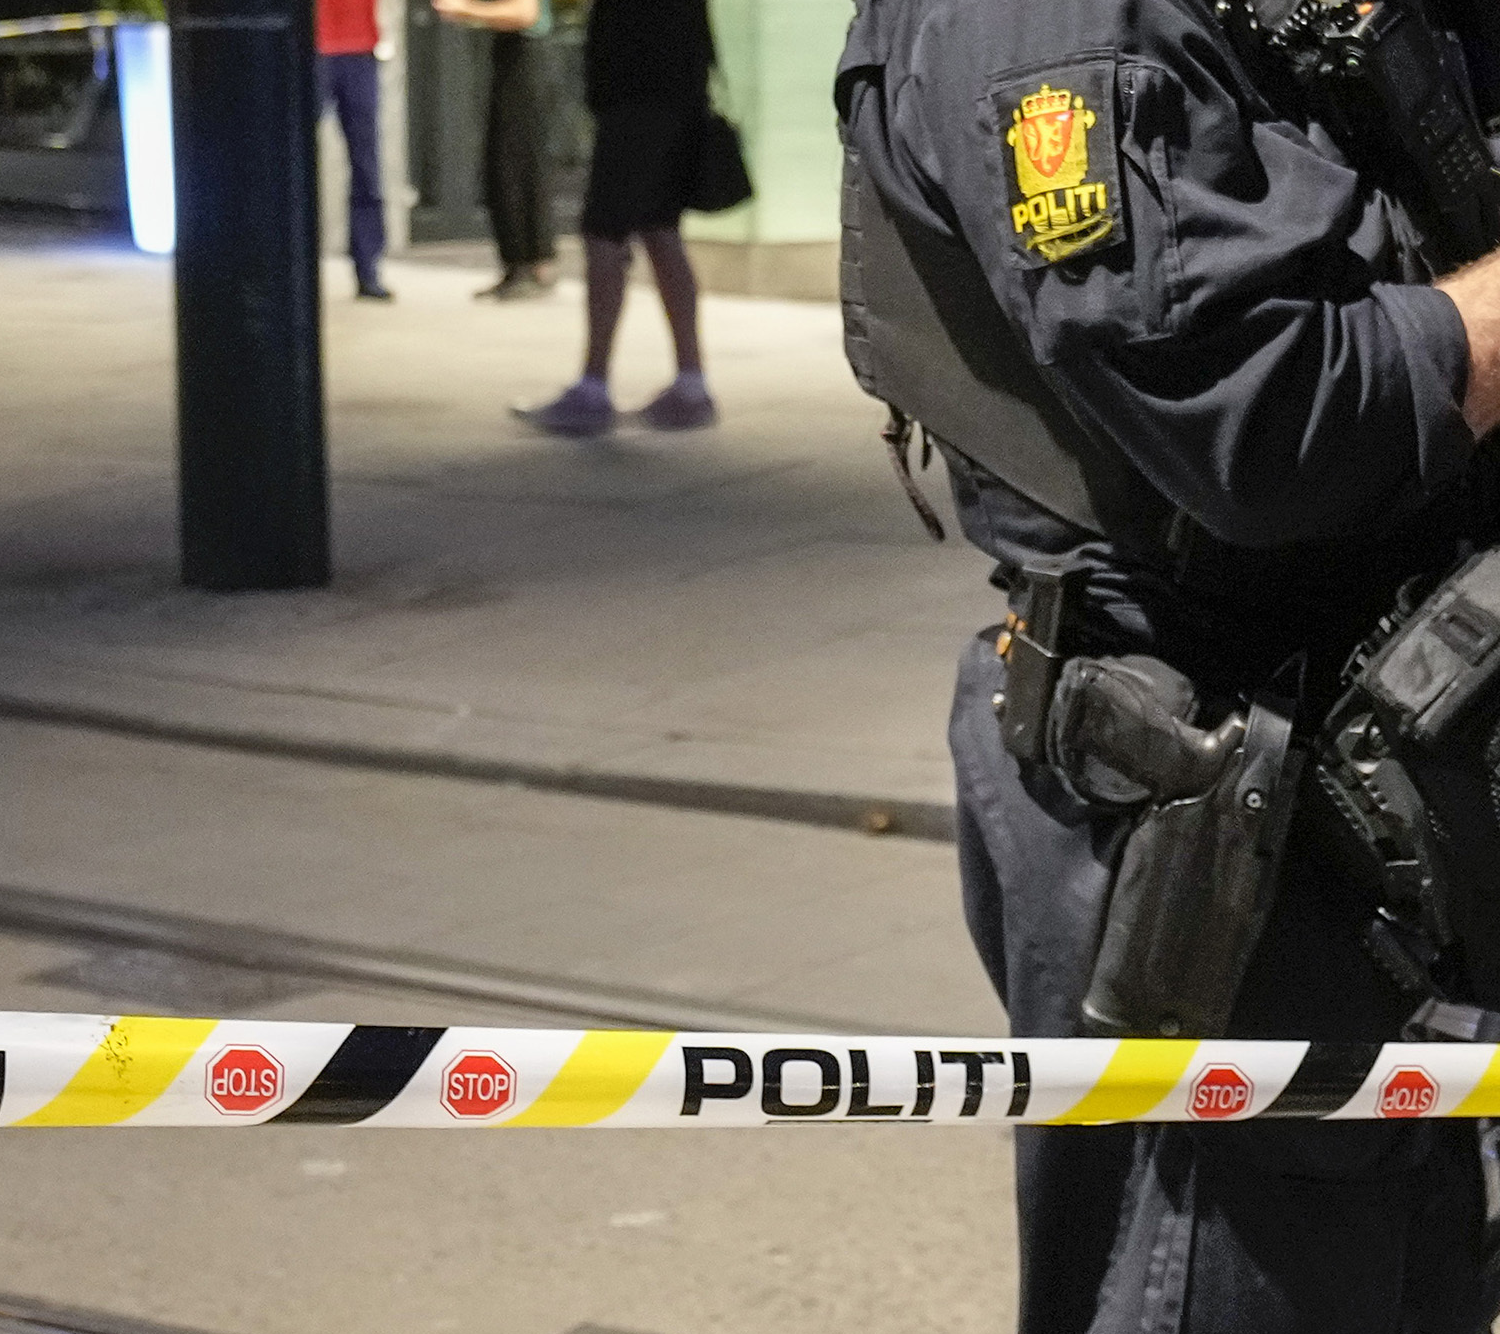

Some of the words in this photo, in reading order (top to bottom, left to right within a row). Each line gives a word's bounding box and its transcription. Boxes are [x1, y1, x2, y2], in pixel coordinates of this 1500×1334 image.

[1011, 180, 1107, 234] POLITI
[213, 1067, 277, 1097] STOP
[449, 1072, 509, 1101] STOP
[679, 1046, 1032, 1117] POLITI
[1194, 1085, 1248, 1110] STOP
[1382, 1087, 1434, 1111] STOP
